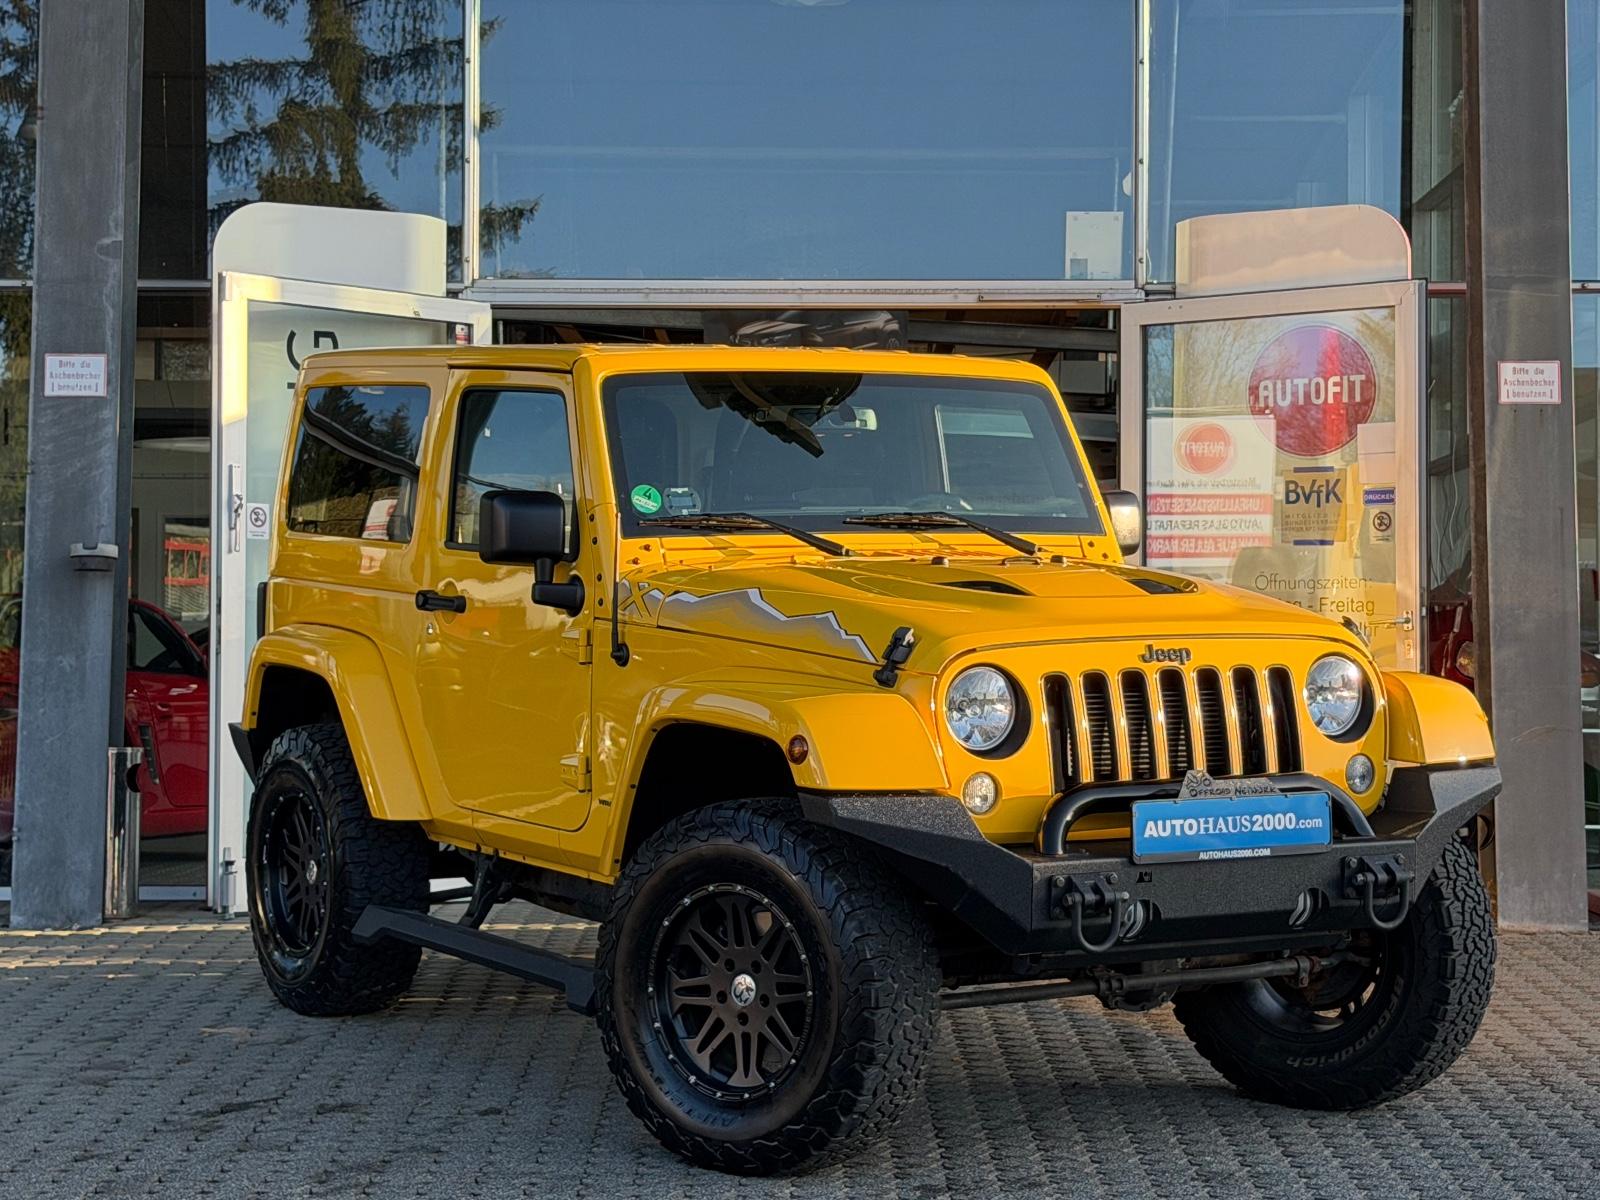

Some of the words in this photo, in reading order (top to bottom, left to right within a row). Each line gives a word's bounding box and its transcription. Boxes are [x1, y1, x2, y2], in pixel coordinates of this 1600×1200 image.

[58, 359, 75, 369] Bitte
[1512, 366, 1529, 375] Bitte
[1533, 366, 1545, 375] die
[1258, 374, 1366, 408] AUTOFIT
[643, 487, 653, 500] 4
[1254, 571, 1373, 595] Öffnungszeiten:
[1319, 597, 1375, 616] Freitag
[1138, 644, 1192, 665] Jeep
[1143, 812, 1324, 838] AUTOHAUS2000.com
[1198, 847, 1271, 861] AUTOHAUS2000.COM
